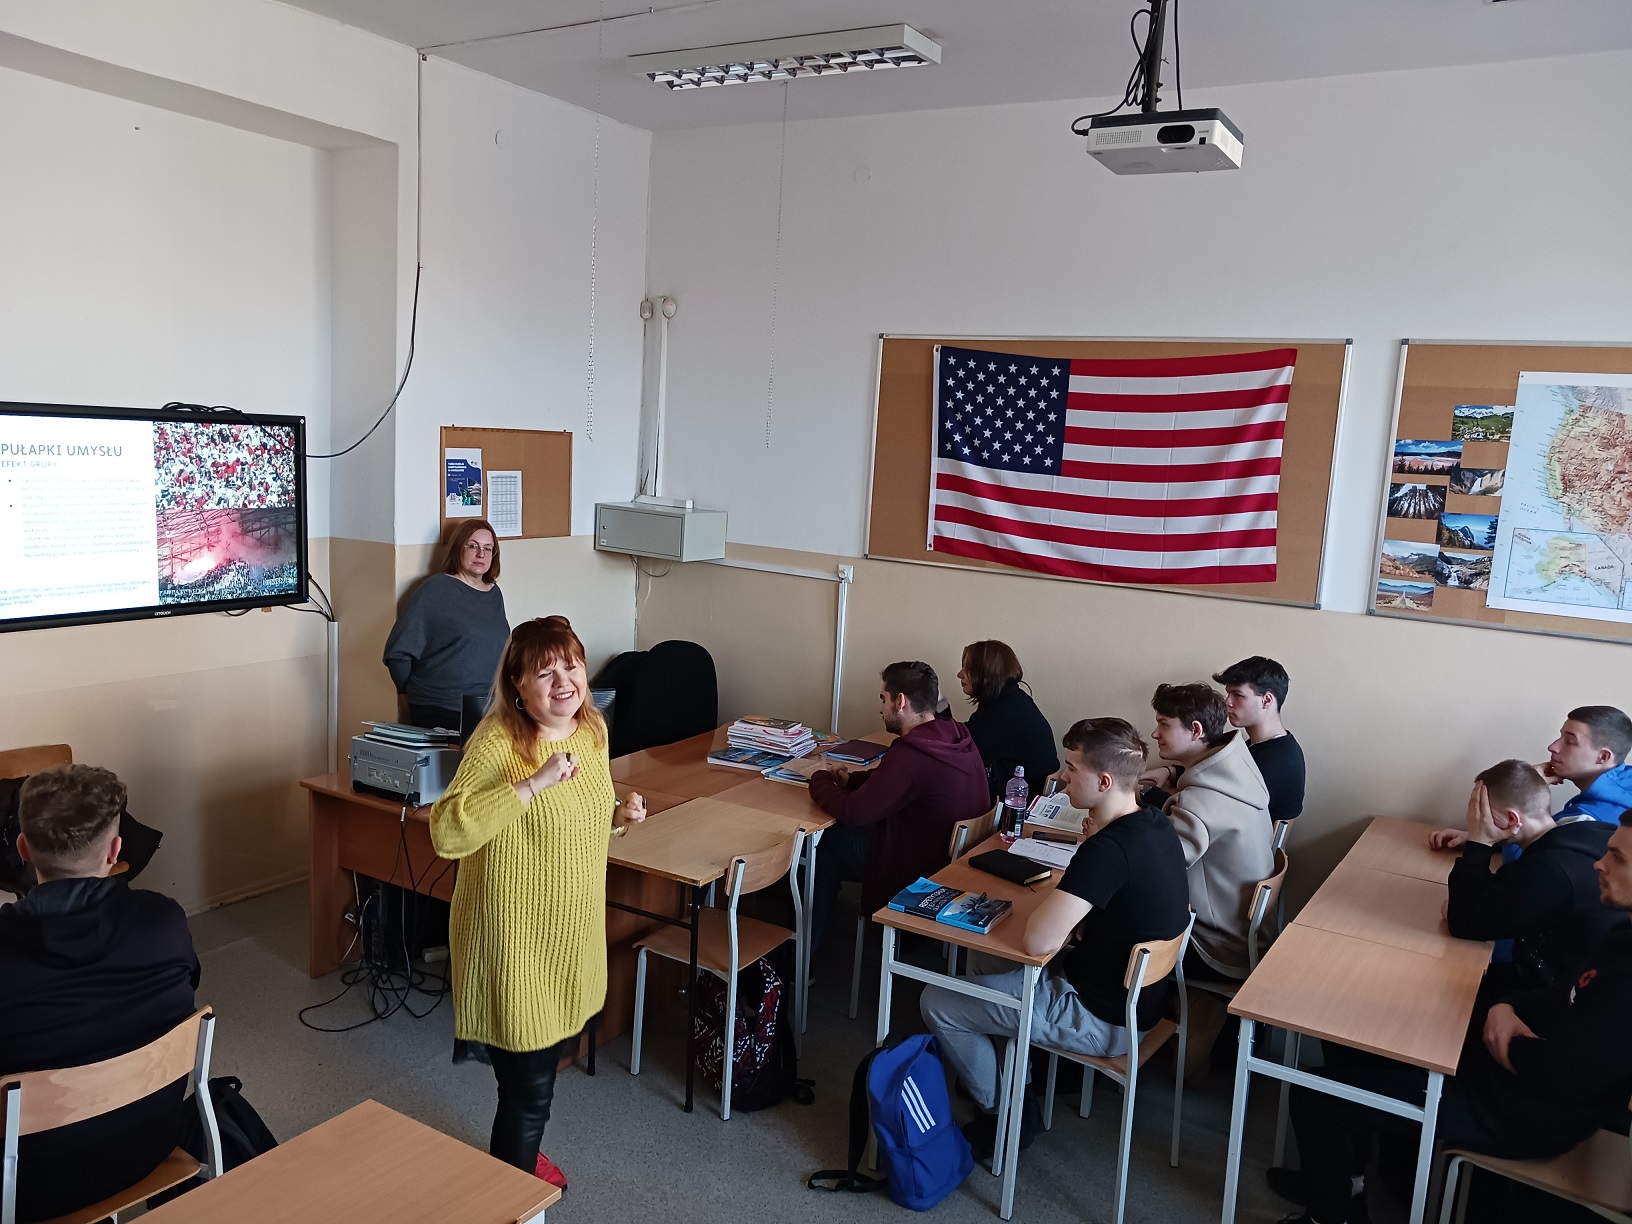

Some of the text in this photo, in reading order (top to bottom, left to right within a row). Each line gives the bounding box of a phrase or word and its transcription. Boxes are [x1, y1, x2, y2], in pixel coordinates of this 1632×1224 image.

[1, 443, 122, 457] PUŁAPKI UMYSŁU
[1, 460, 58, 469] EFEKT GRUPY
